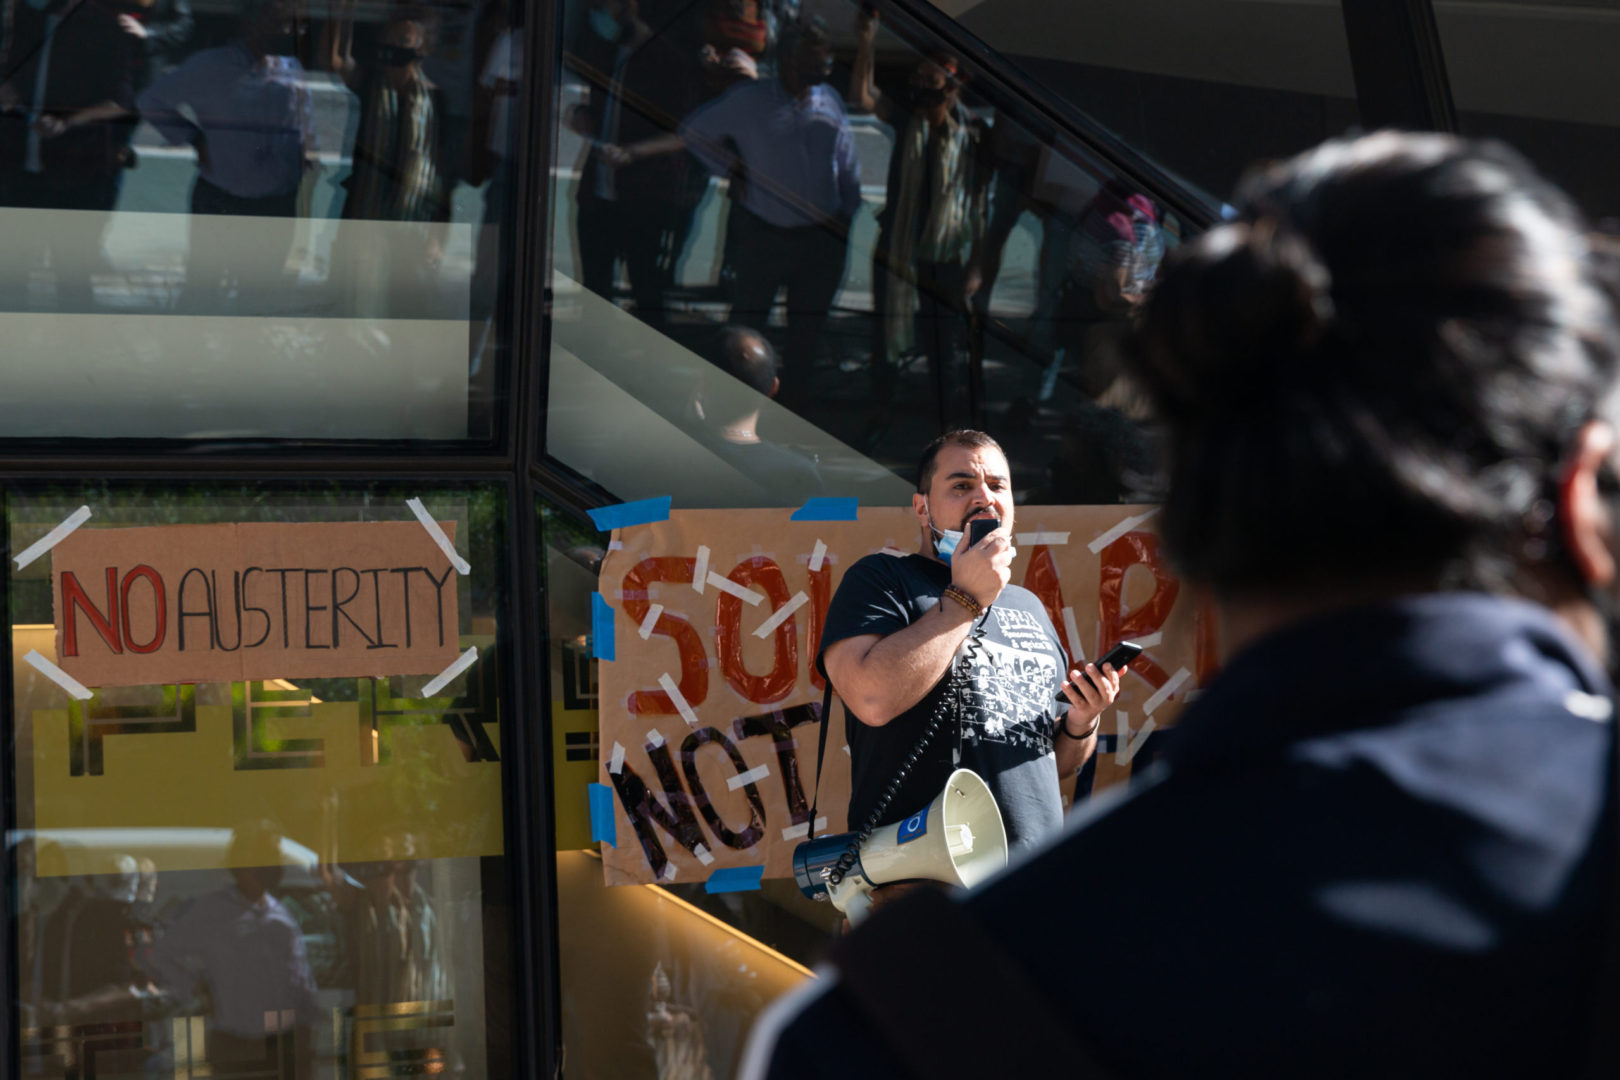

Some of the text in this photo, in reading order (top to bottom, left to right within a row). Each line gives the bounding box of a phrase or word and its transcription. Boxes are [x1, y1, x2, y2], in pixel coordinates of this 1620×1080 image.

[61, 564, 454, 658] NO AUSTERITY
[607, 702, 822, 879] NOT
